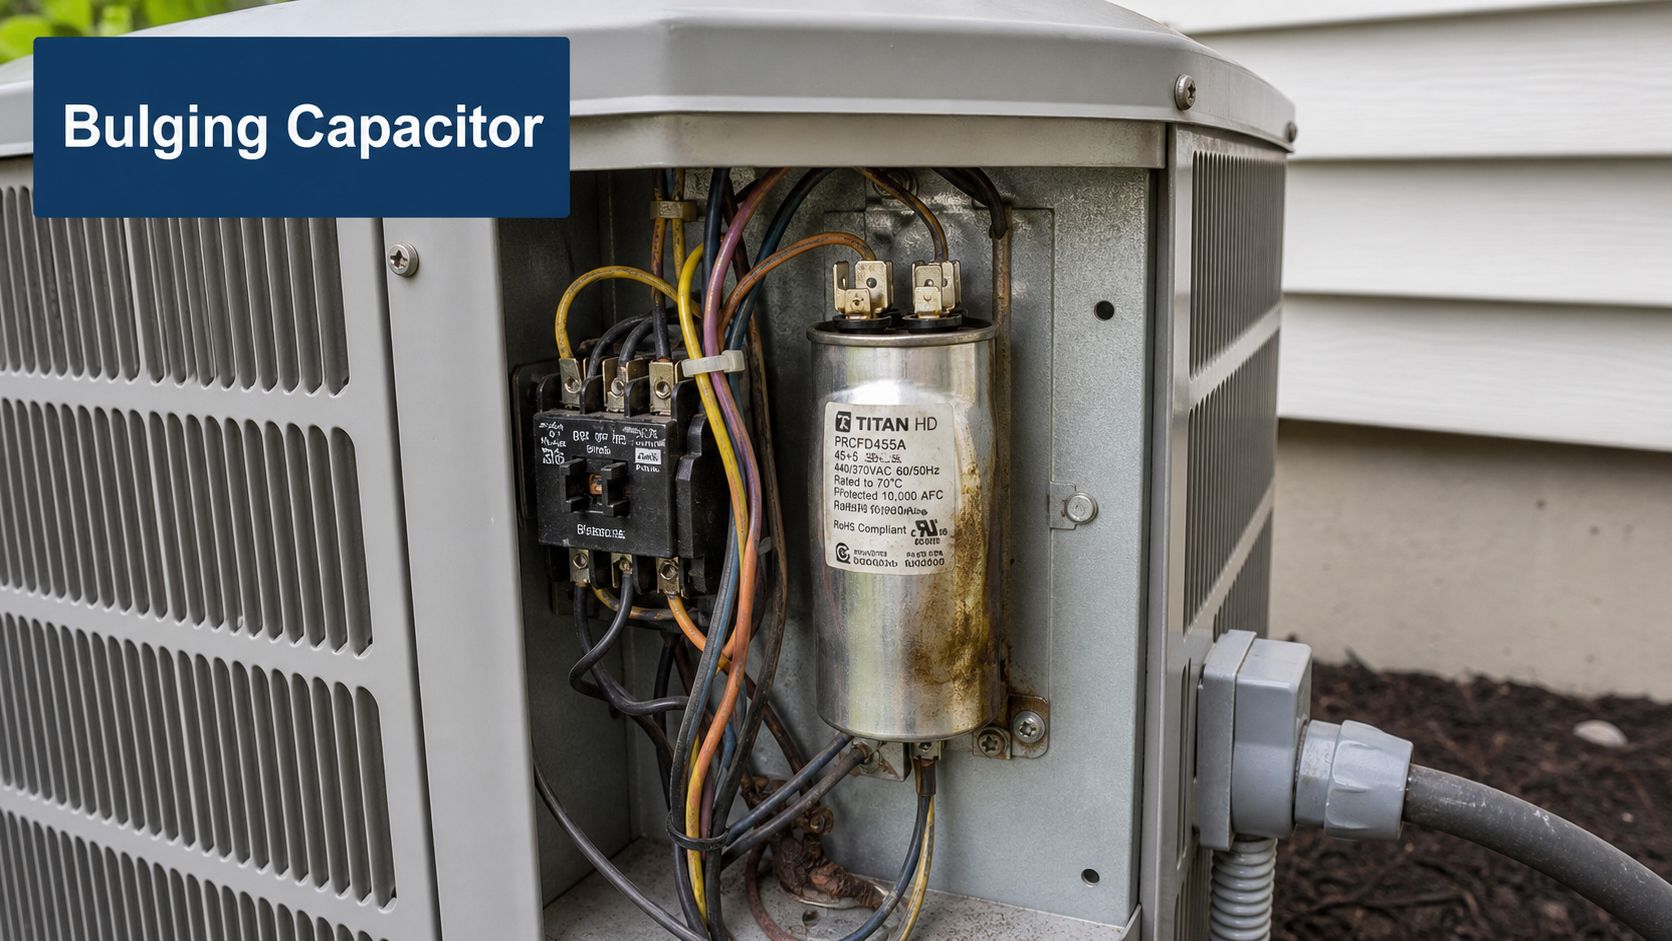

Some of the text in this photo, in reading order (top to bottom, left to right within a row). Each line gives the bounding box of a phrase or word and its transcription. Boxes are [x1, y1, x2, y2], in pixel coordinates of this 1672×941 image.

[856, 416, 938, 432] TITAN HD
[834, 436, 906, 450] PRCFD455A
[834, 463, 940, 476] 440/370VAC 60/50Hz
[834, 474, 860, 487] Rated
[864, 478, 873, 488] to
[920, 490, 944, 500] AFC
[833, 520, 907, 536] RoHS Compliant
